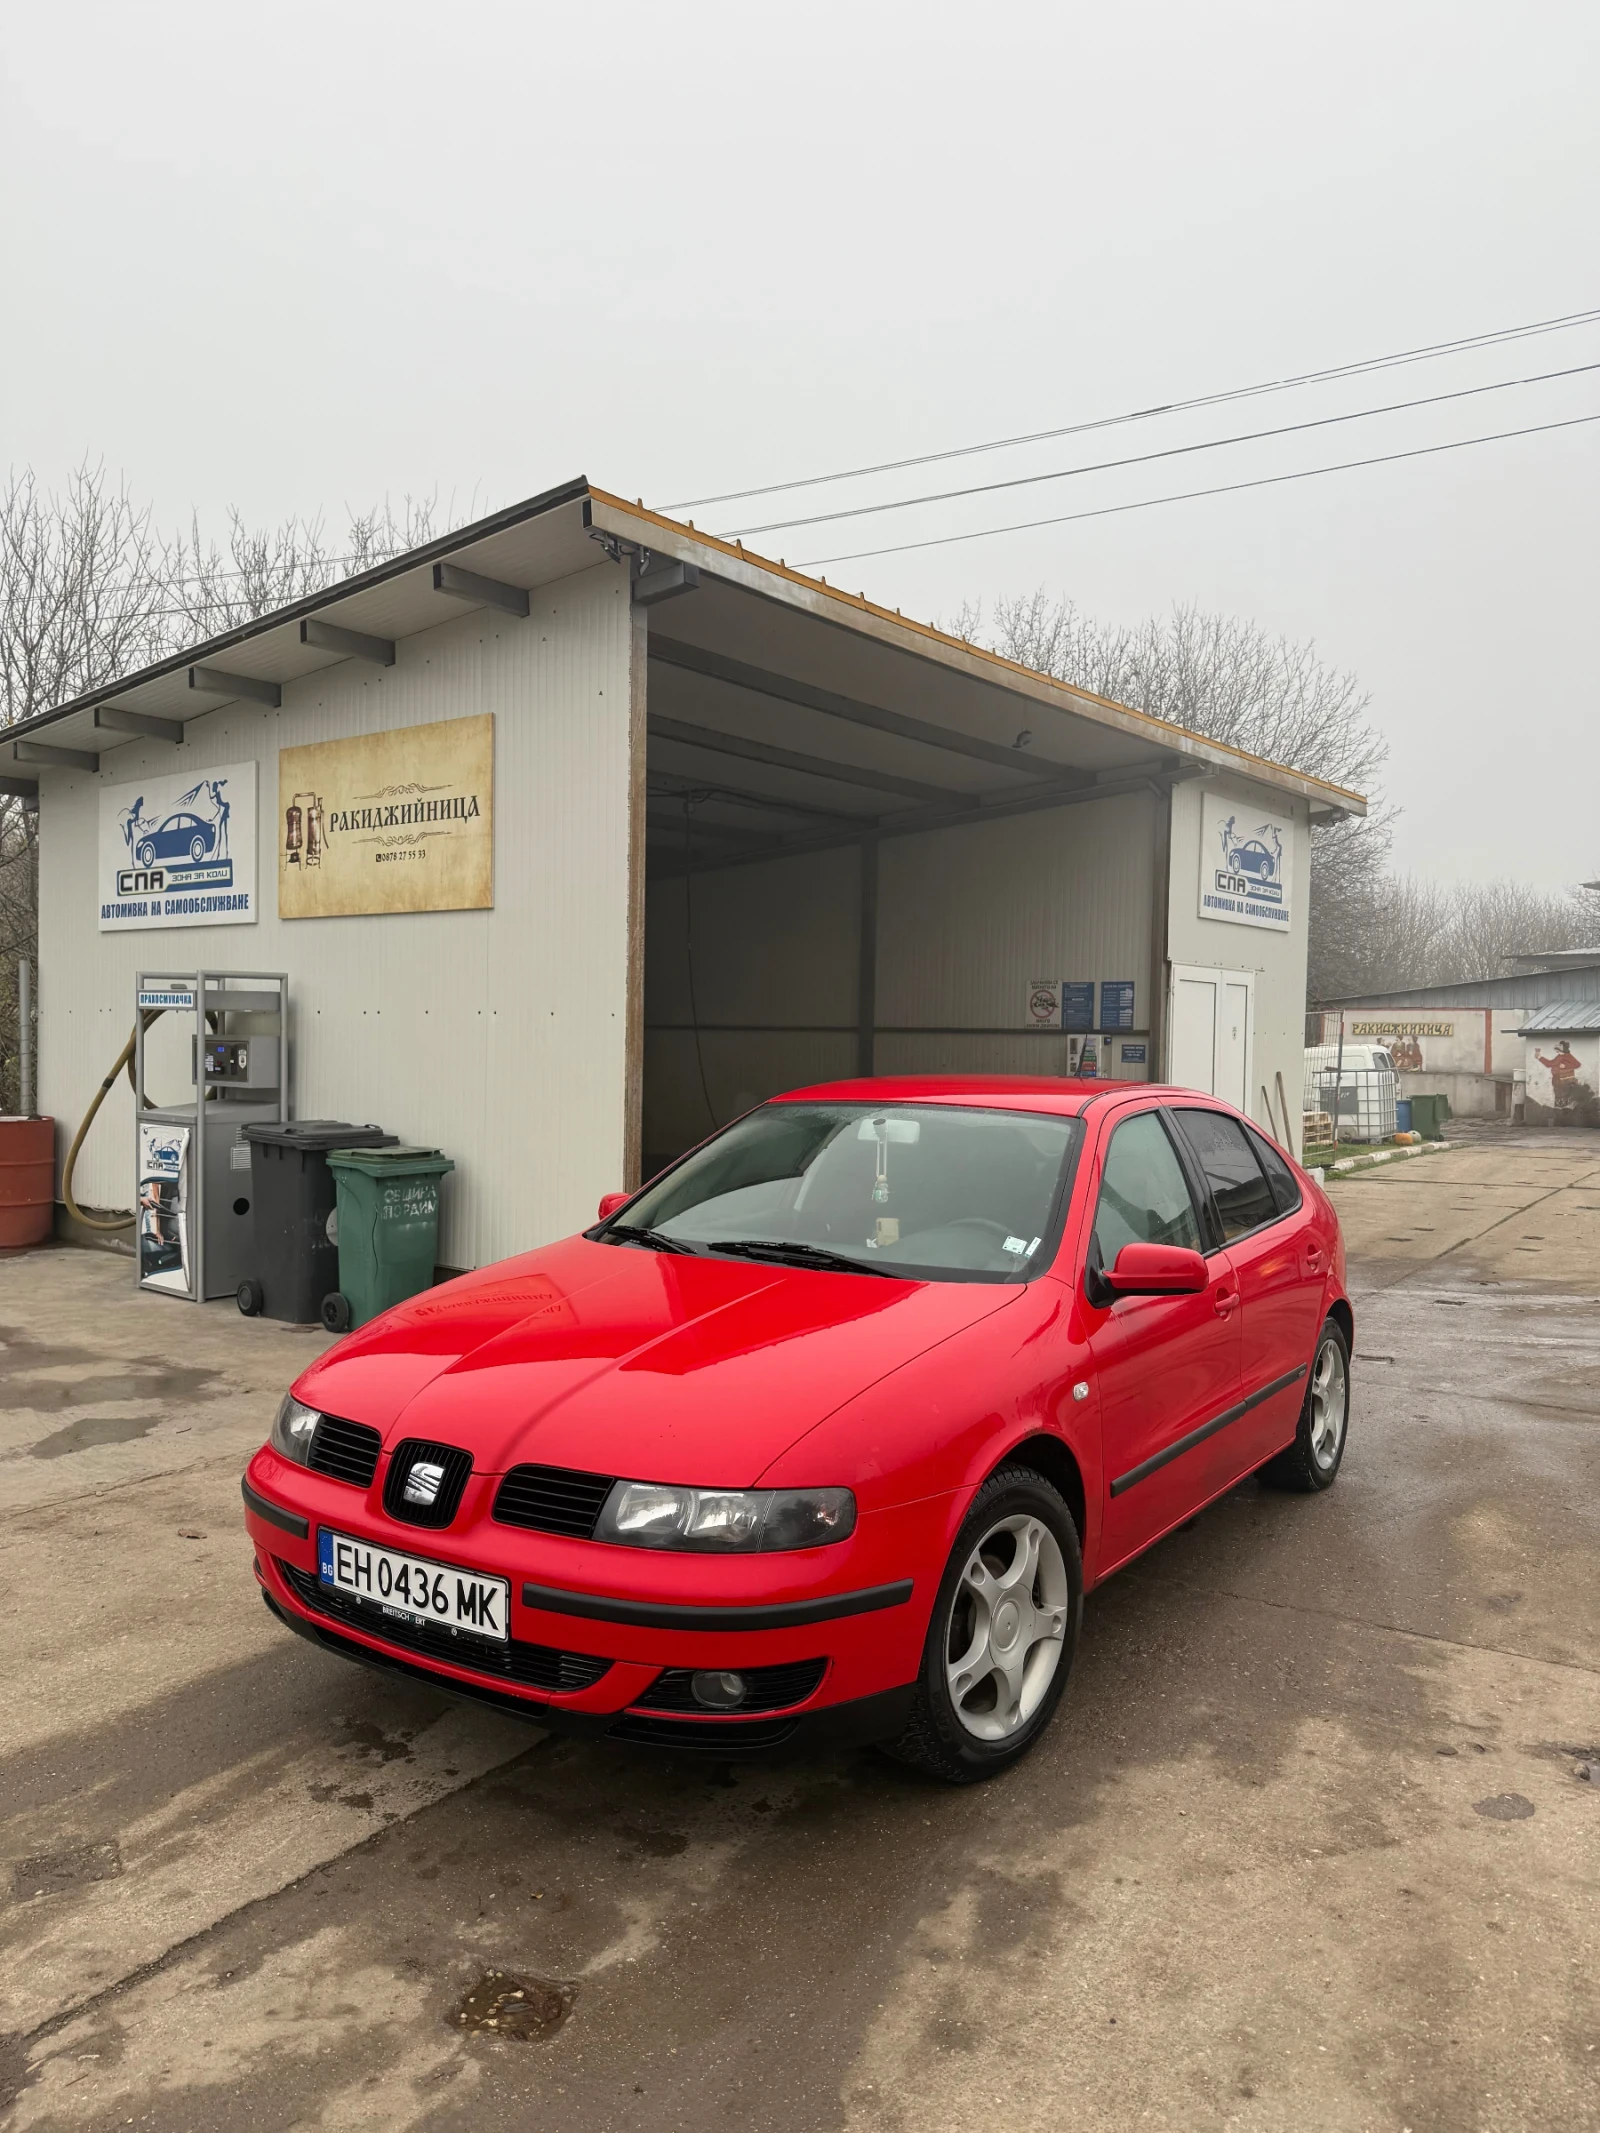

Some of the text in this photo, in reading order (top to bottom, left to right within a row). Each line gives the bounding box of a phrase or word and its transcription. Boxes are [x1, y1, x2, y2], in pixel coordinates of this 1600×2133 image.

[329, 795, 481, 833] РАКИДЖИЙНИЦА
[382, 852, 397, 862] 0878
[408, 850, 416, 860] 55
[418, 849, 426, 859] 33
[120, 870, 164, 892] СПА
[172, 869, 228, 882] ЗОНА ЗА КОЛИ
[1217, 873, 1246, 894] СПА
[101, 894, 249, 919] АВТОМИВКА НА САМООБСЛУЖВАНЕ
[1236, 900, 1244, 914] НА
[140, 994, 192, 1004] ПРАХОСМУКАЧКА
[147, 1161, 164, 1169] СПА
[384, 1185, 437, 1203] ОБЩИНА
[322, 1562, 334, 1577] BG
